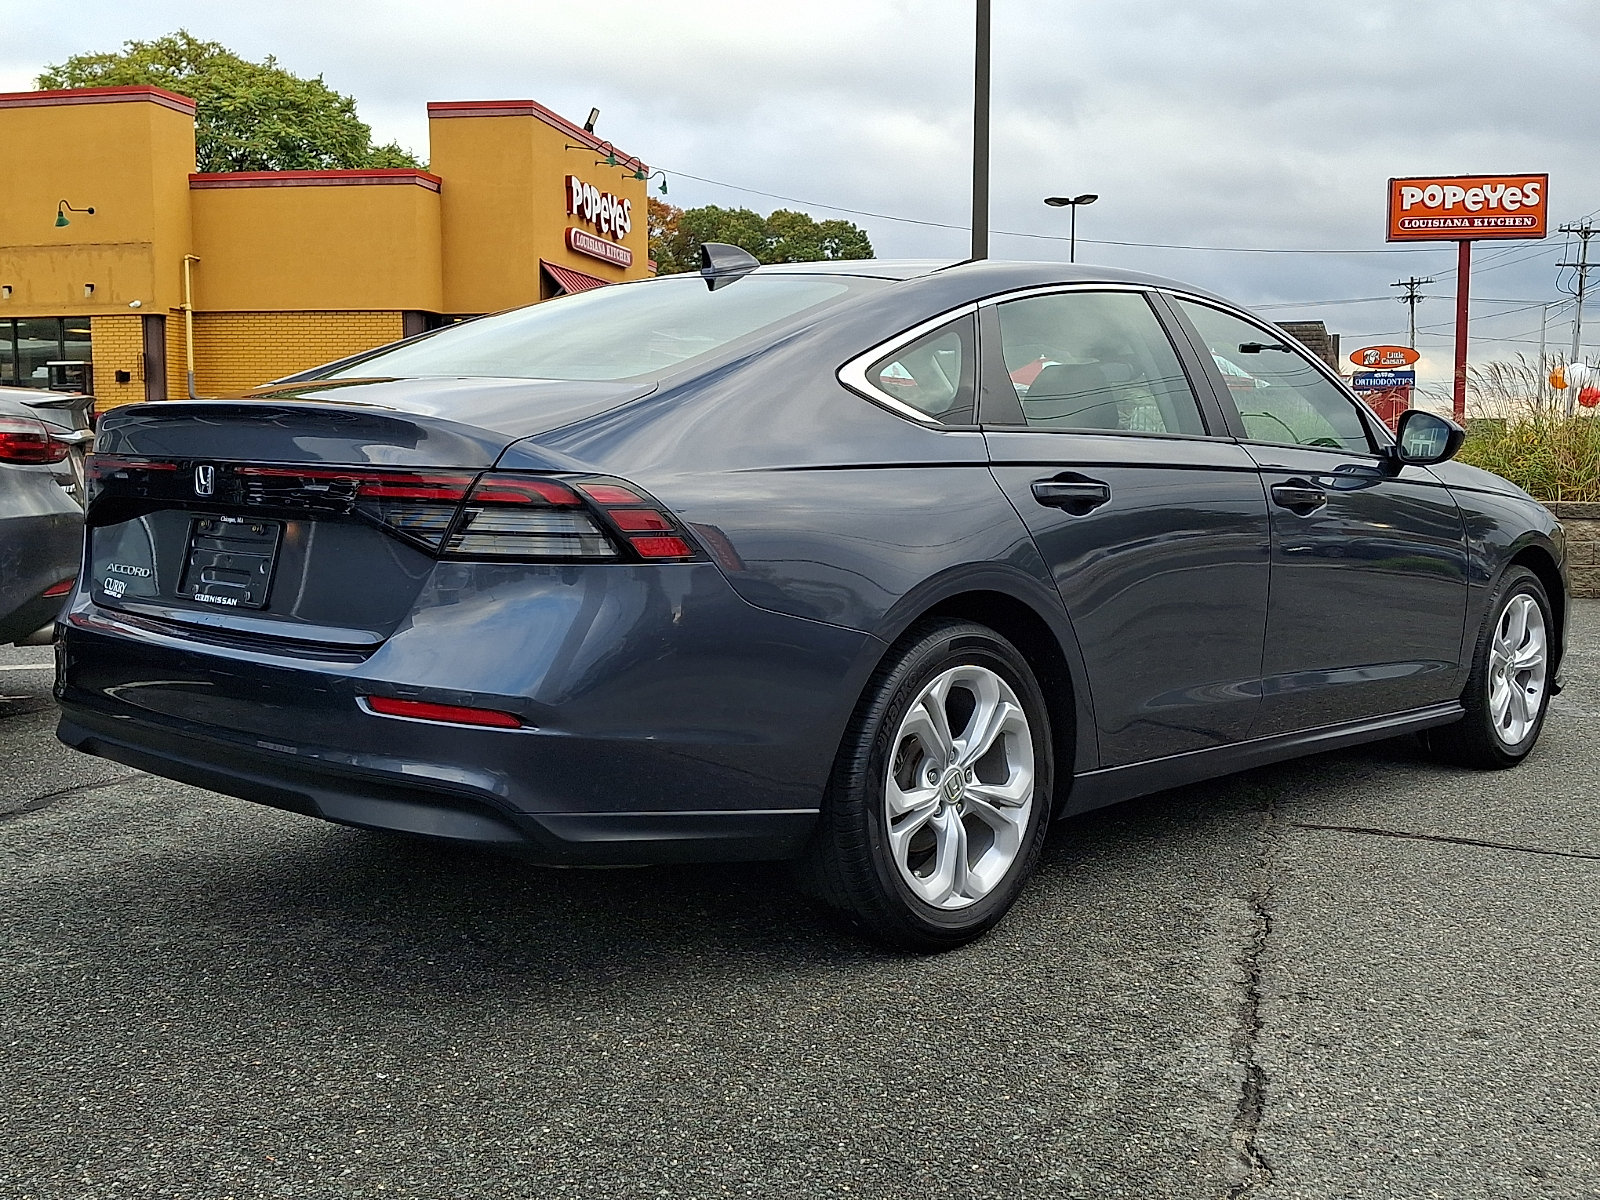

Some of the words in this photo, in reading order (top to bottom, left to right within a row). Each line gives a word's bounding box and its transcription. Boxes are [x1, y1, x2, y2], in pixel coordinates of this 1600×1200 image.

[1403, 218, 1469, 228] LOUISIANA
[1473, 217, 1533, 227] KITCHEN
[576, 233, 606, 255] LOUISIANA
[606, 244, 631, 264] KITCHEN
[1386, 351, 1405, 359] Little
[1381, 357, 1406, 365] Caesars
[1354, 377, 1414, 387] ORTHODONTICS
[106, 563, 151, 578] ACCORD
[104, 577, 128, 595] CURRY
